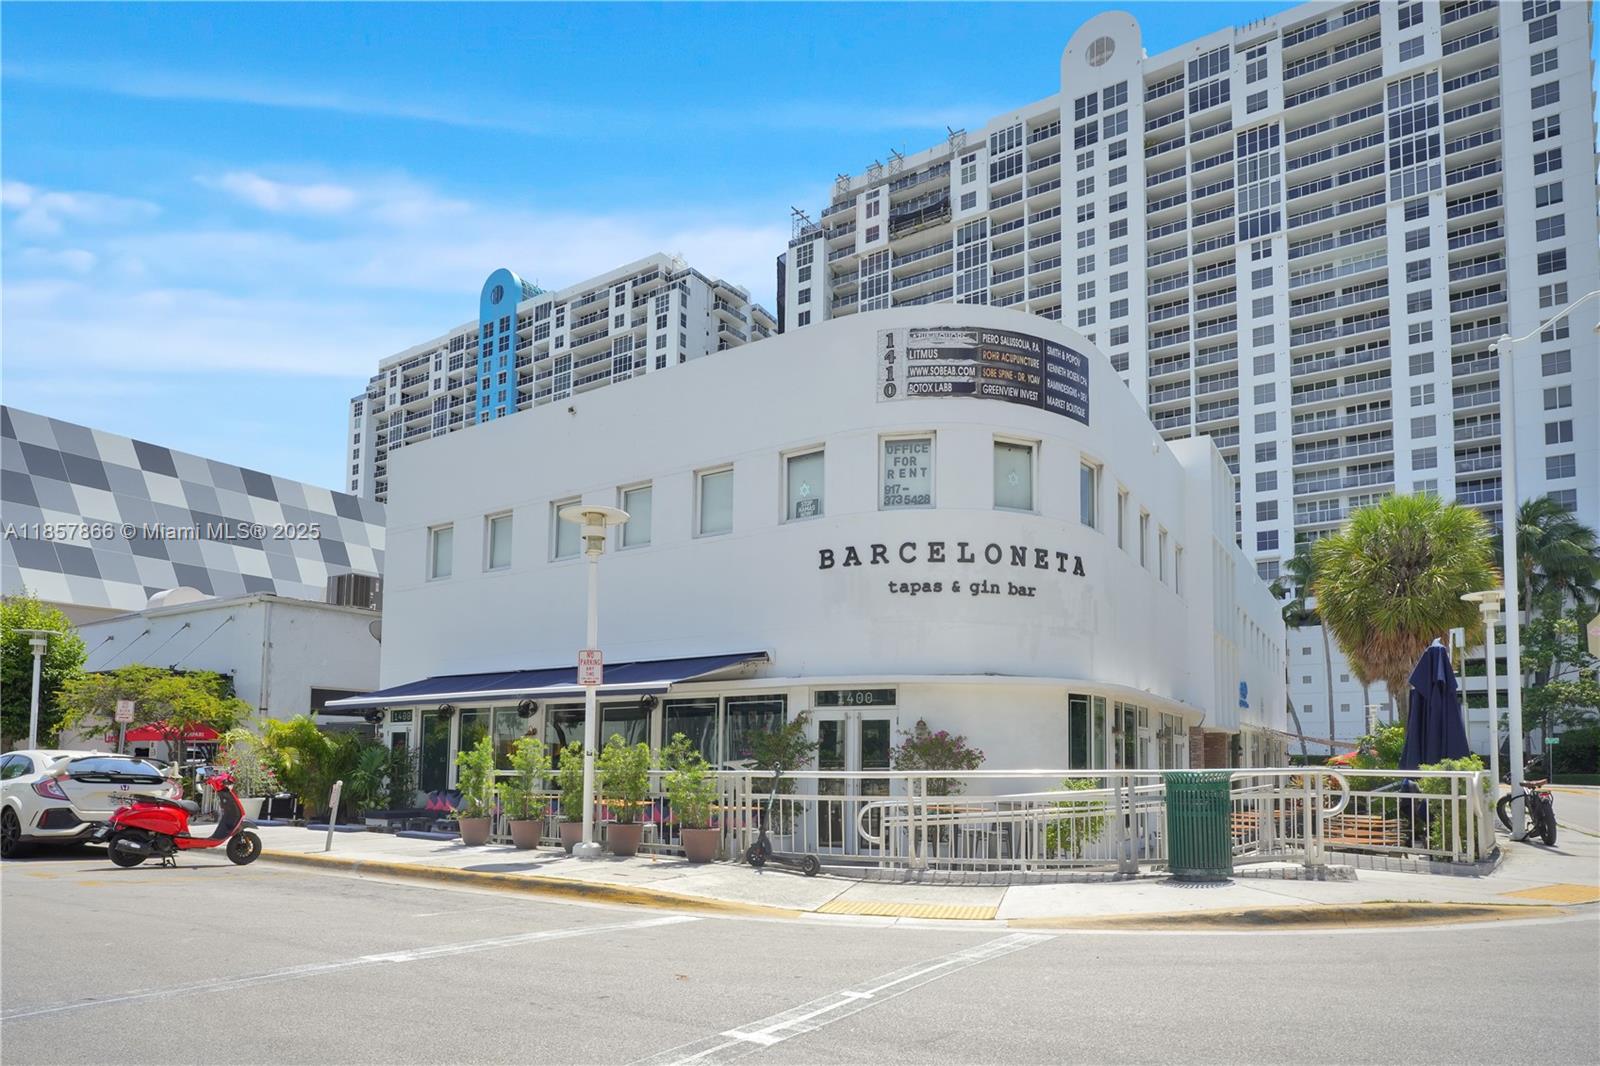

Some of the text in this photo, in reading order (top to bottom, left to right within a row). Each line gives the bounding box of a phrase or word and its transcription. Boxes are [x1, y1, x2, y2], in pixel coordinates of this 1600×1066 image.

[982, 333, 999, 344] PIERO
[1031, 343, 1041, 352] P.A.
[909, 349, 938, 360] LITMUS
[982, 350, 1040, 369] ROHR ACUPUNCTURE
[1047, 345, 1061, 358] SMITH
[982, 368, 997, 378] SOBE
[997, 370, 1013, 380] SPINE
[1017, 372, 1027, 383] DR.
[1027, 373, 1040, 385] YOAV
[1047, 363, 1066, 377] KENNETH
[1066, 368, 1080, 383] ROSEN
[909, 383, 934, 394] BOTOX
[982, 384, 1039, 402] GREENVIEW INVEST
[1046, 395, 1086, 418] MARKET BOUTIQUE
[886, 443, 929, 455] OFFICE
[893, 456, 917, 467] FOR
[887, 467, 927, 479] RENT
[818, 541, 1087, 577] BARCELONETA
[888, 579, 1037, 597] tapas & gin bar
[580, 658, 601, 666] PARKING
